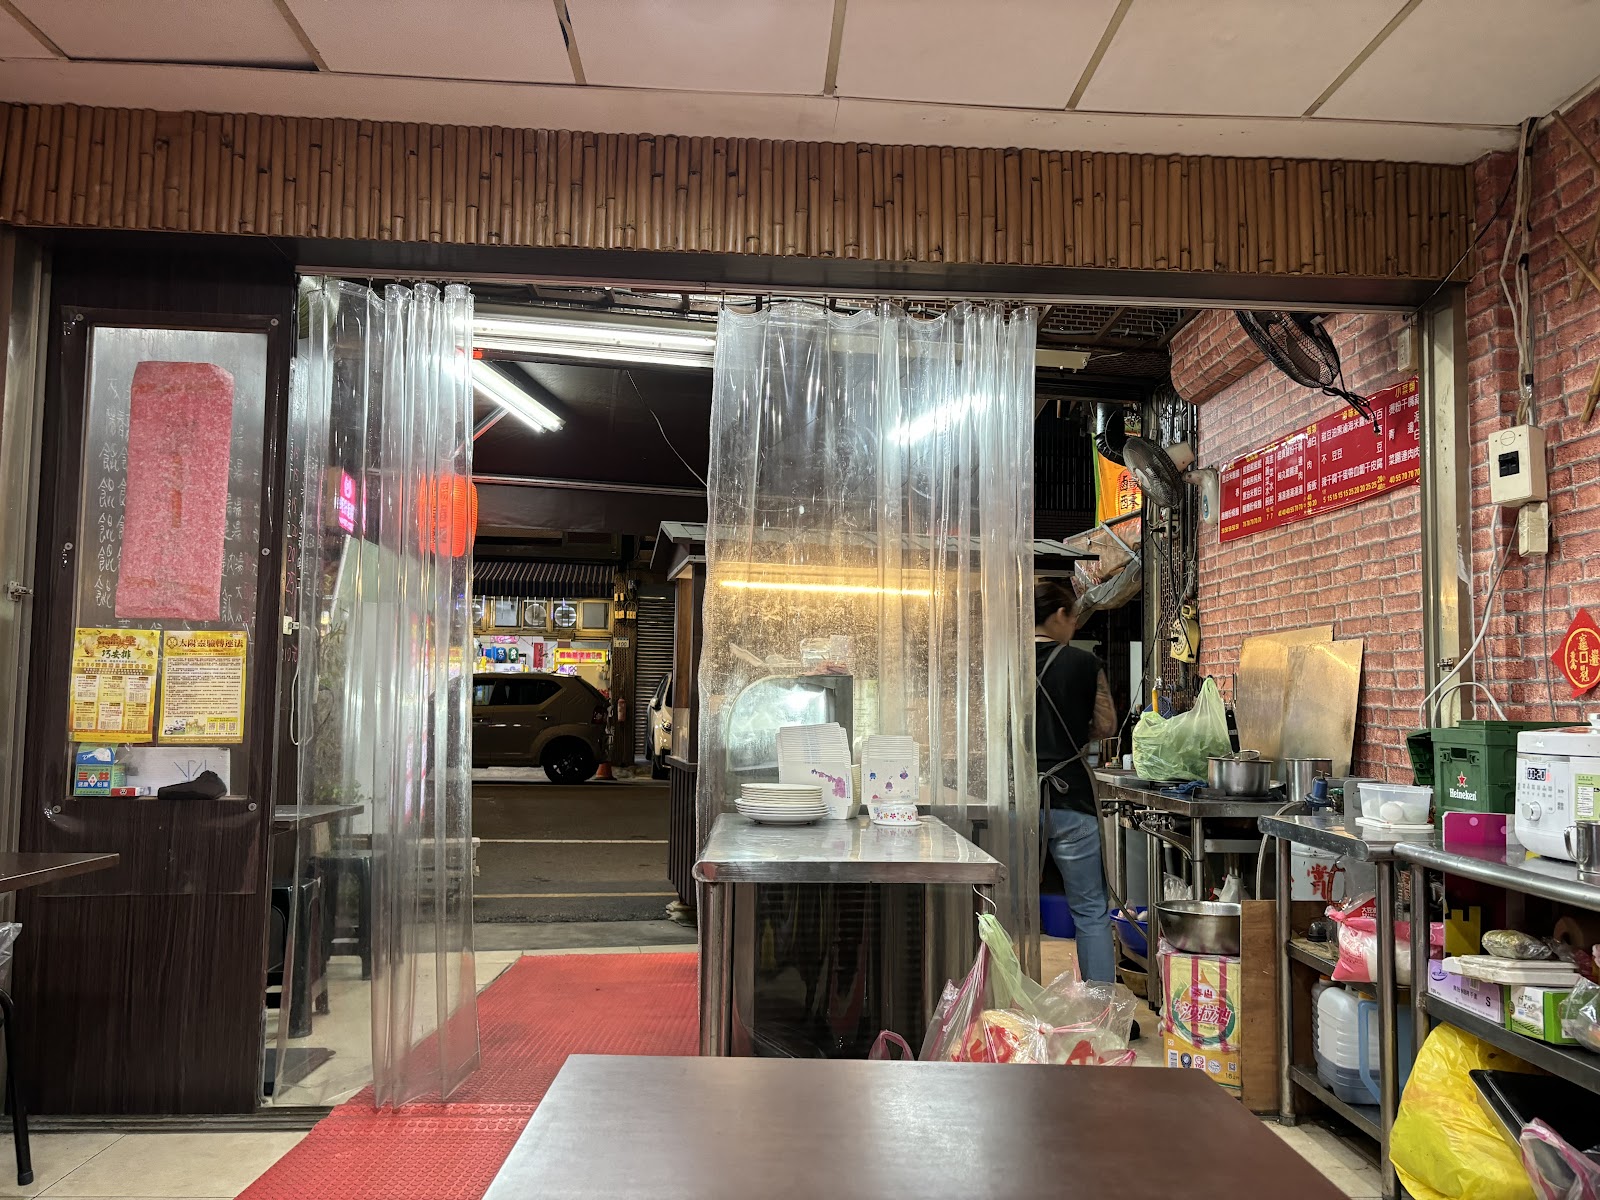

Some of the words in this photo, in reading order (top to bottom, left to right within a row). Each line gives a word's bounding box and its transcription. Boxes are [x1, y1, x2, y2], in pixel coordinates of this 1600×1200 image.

[1396, 380, 1416, 398] 小菜類
[102, 650, 132, 659] 巧安排
[1450, 788, 1477, 801] Heineken
[1486, 996, 1491, 1007] S
[1180, 1002, 1232, 1026] 沙拉油
